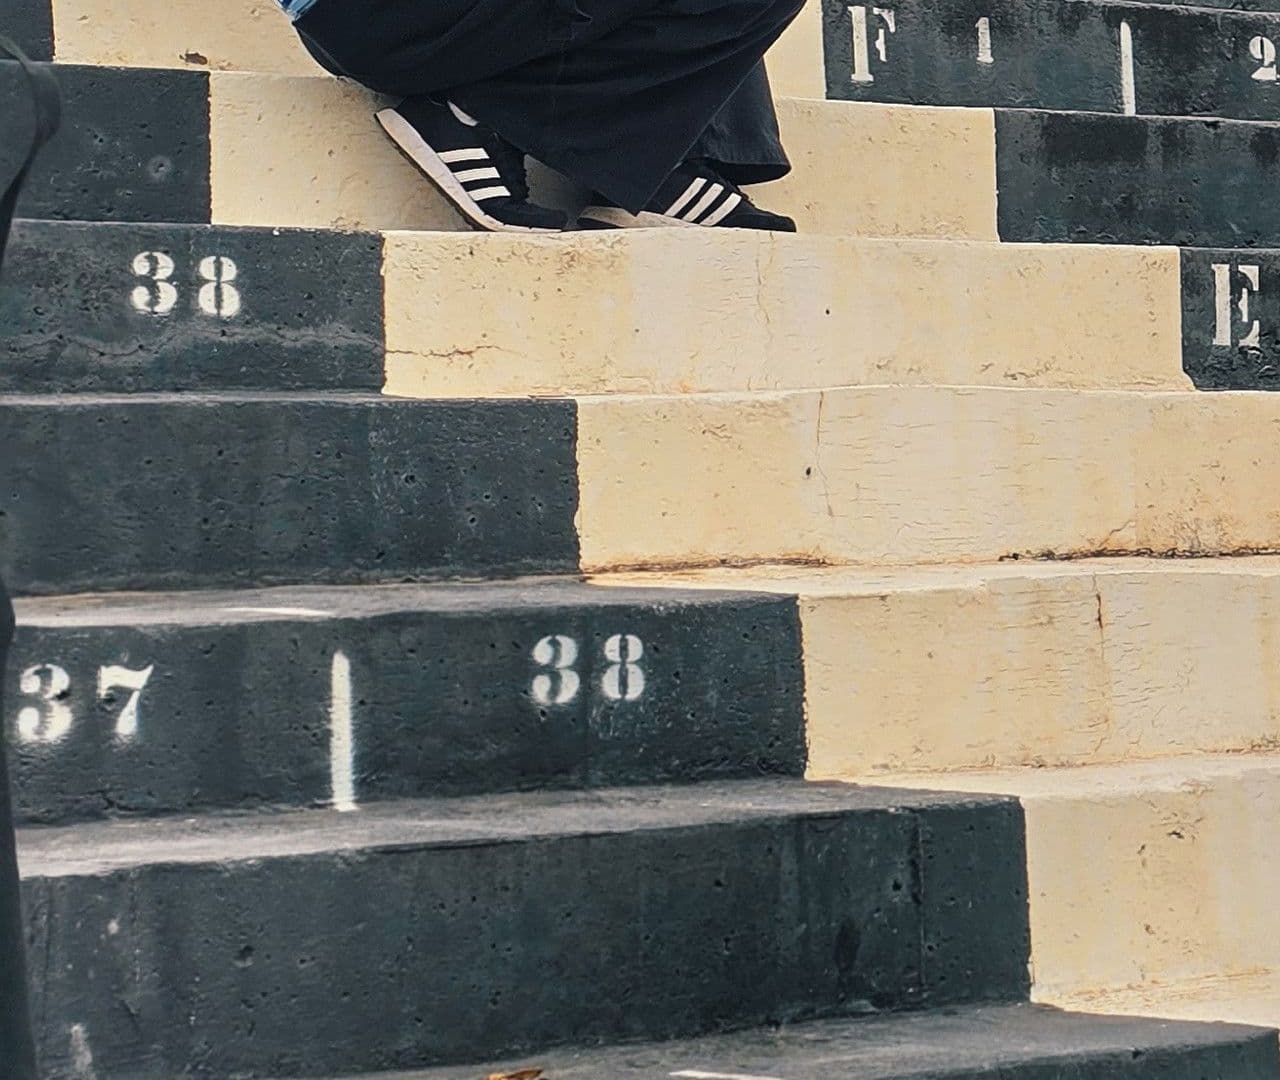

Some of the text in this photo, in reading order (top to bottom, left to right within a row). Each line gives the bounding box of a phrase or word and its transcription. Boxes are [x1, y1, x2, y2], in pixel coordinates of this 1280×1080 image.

[848, 6, 895, 82] F
[976, 18, 994, 65] 1
[1250, 36, 1280, 81] 2
[131, 252, 240, 318] 38
[1211, 264, 1260, 347] E
[16, 634, 645, 744] 37 38
